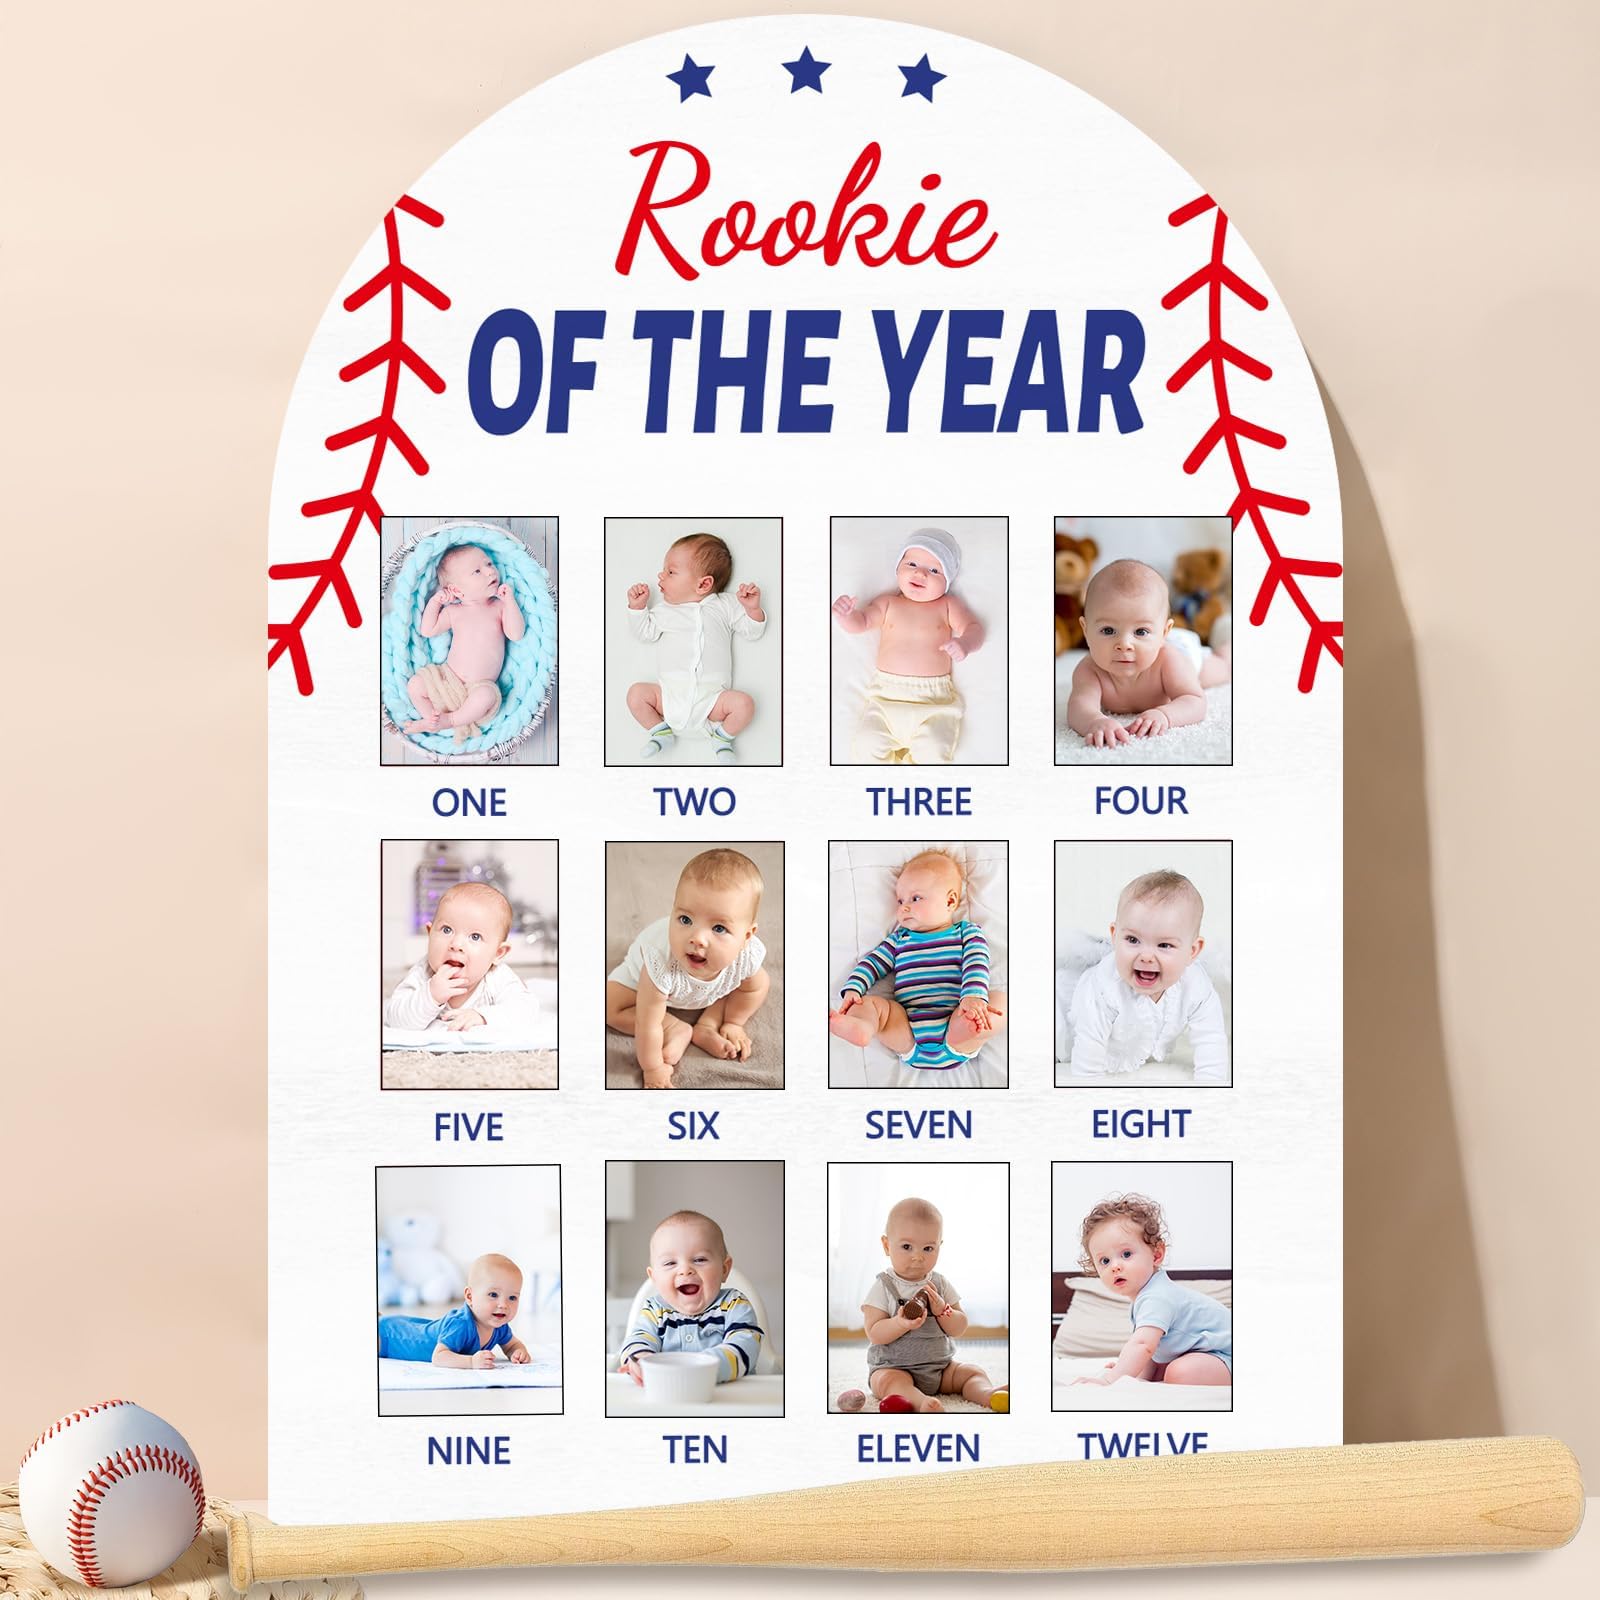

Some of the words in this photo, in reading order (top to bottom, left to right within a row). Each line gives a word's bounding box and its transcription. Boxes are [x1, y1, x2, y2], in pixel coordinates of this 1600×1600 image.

[615, 141, 998, 281] Rookie
[468, 309, 606, 435] OF
[633, 310, 841, 433] THE
[872, 310, 1145, 434] YEAR
[432, 787, 507, 817] ONE
[653, 786, 736, 817] TWO
[865, 787, 972, 816] THREE
[1096, 785, 1188, 815] FOUR
[435, 1112, 503, 1142] FIVE
[668, 1110, 720, 1140] SIX
[866, 1109, 972, 1140] SEVEN
[1093, 1109, 1192, 1139] EIGHT
[428, 1436, 511, 1465] NINE
[662, 1434, 727, 1464] TEN
[858, 1433, 980, 1463] ELEVEN
